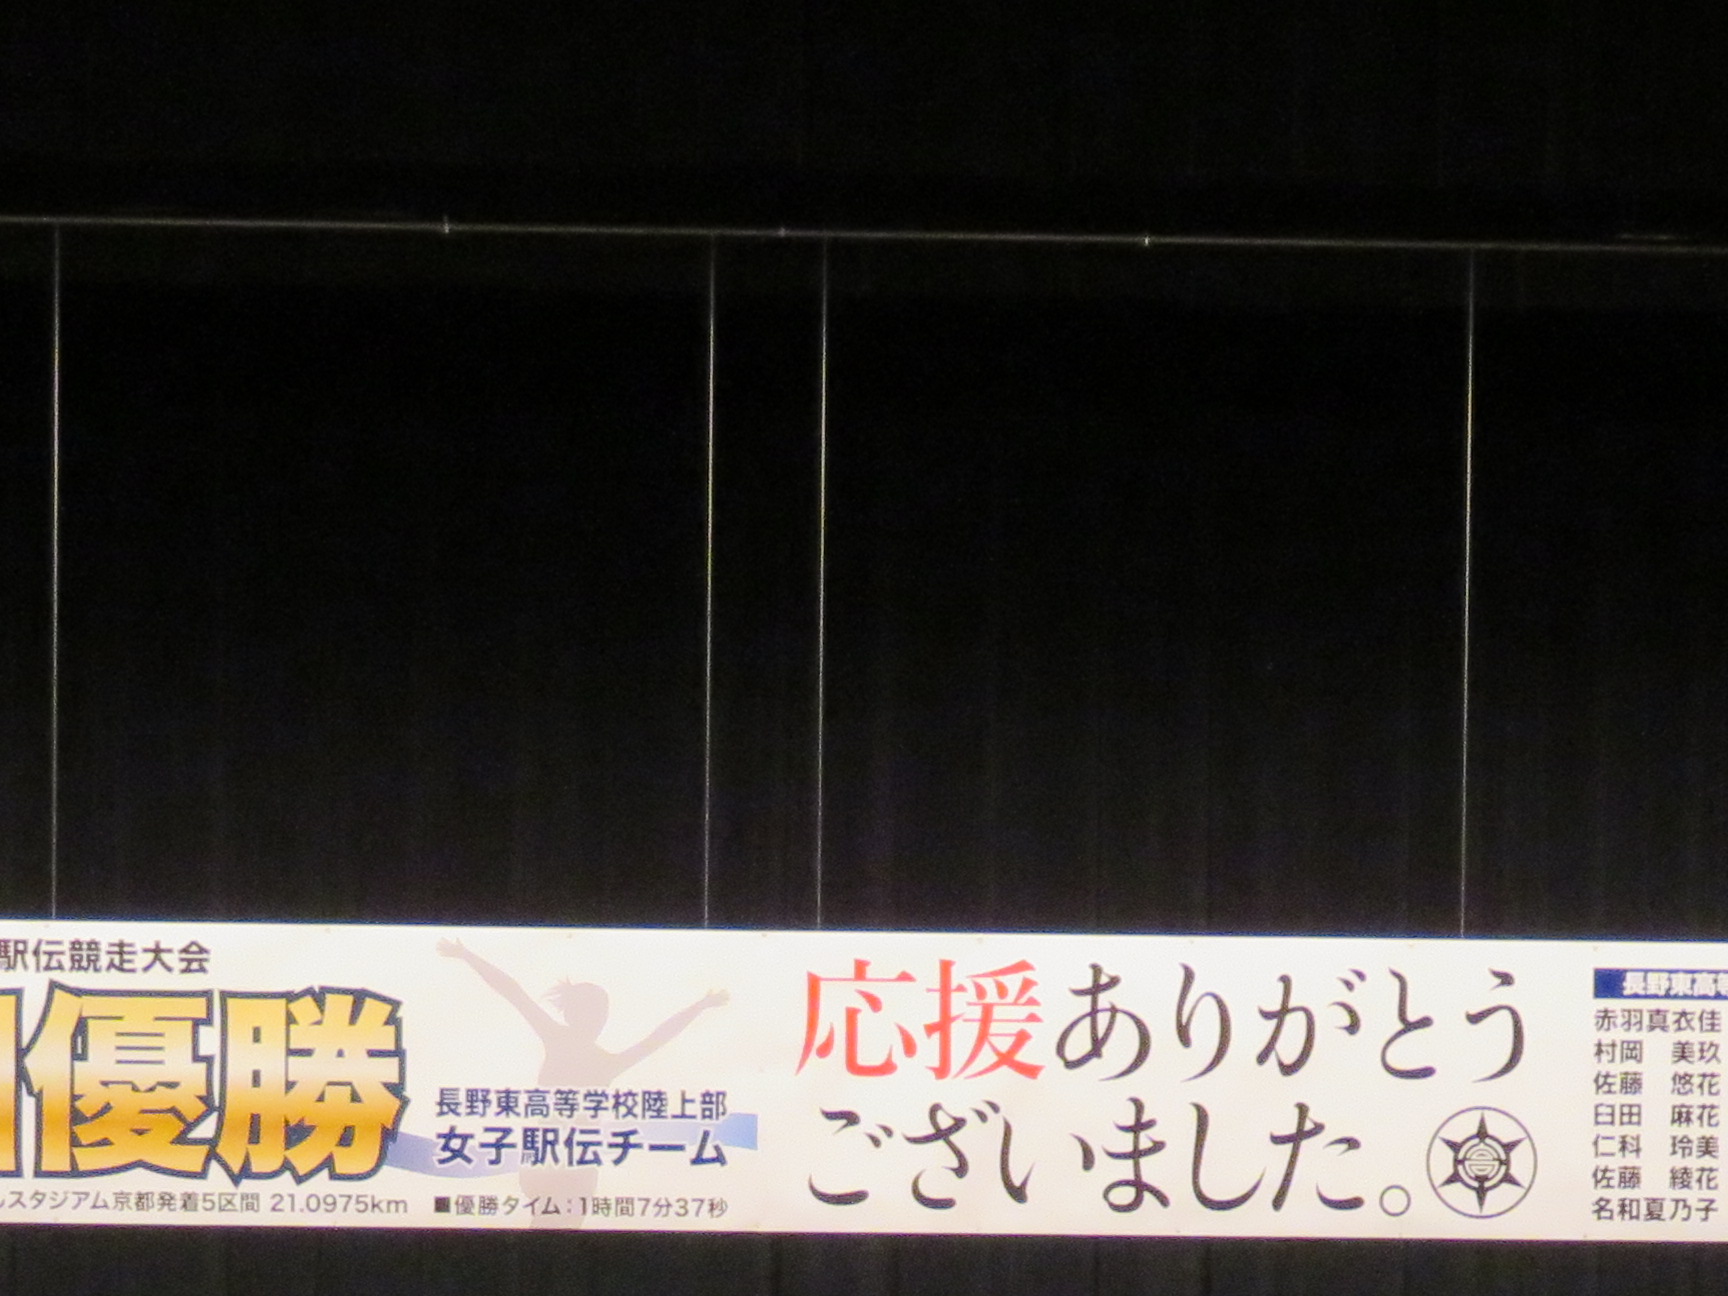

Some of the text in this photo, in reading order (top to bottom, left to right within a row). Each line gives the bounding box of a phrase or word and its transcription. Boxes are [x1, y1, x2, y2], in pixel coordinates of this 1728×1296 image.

[795, 957, 1526, 1083] 応援ありがとう
[1594, 1040, 1643, 1063] 村岡
[1593, 1071, 1642, 1095] 佐藤
[435, 1088, 728, 1121] 長野東高等学校陸上部
[1594, 1103, 1641, 1126] 臼田
[436, 1125, 728, 1168] 女子駅伝チーム
[808, 1096, 1412, 1218] ございました。
[1593, 1134, 1641, 1158] 仁科
[1592, 1166, 1641, 1189] 佐藤
[271, 1194, 407, 1213] 21.0975km
